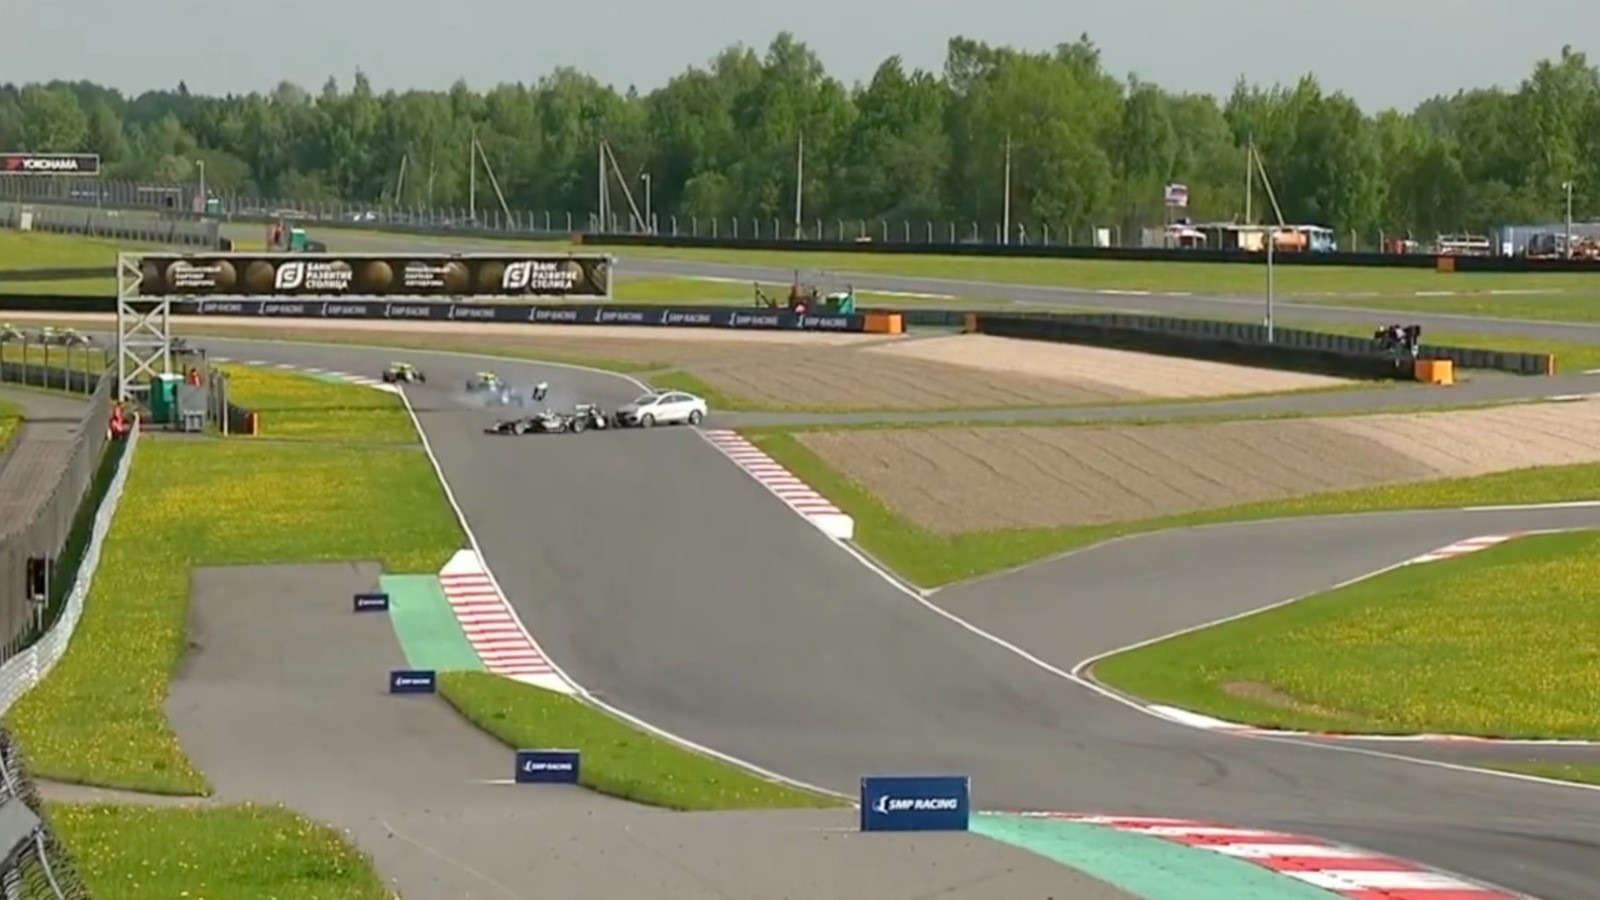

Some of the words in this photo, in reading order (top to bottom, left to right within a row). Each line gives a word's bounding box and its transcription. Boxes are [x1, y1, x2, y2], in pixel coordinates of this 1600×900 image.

[22, 158, 78, 170] YOKOHAMA
[306, 271, 352, 280] РАЗВИТИЕ
[532, 271, 578, 280] РАЗВИТИЕ
[305, 280, 348, 289] СТОЛИЦА
[531, 280, 573, 289] СТОЛИЦА
[888, 799, 914, 810] SMP
[914, 799, 958, 810] RACING
